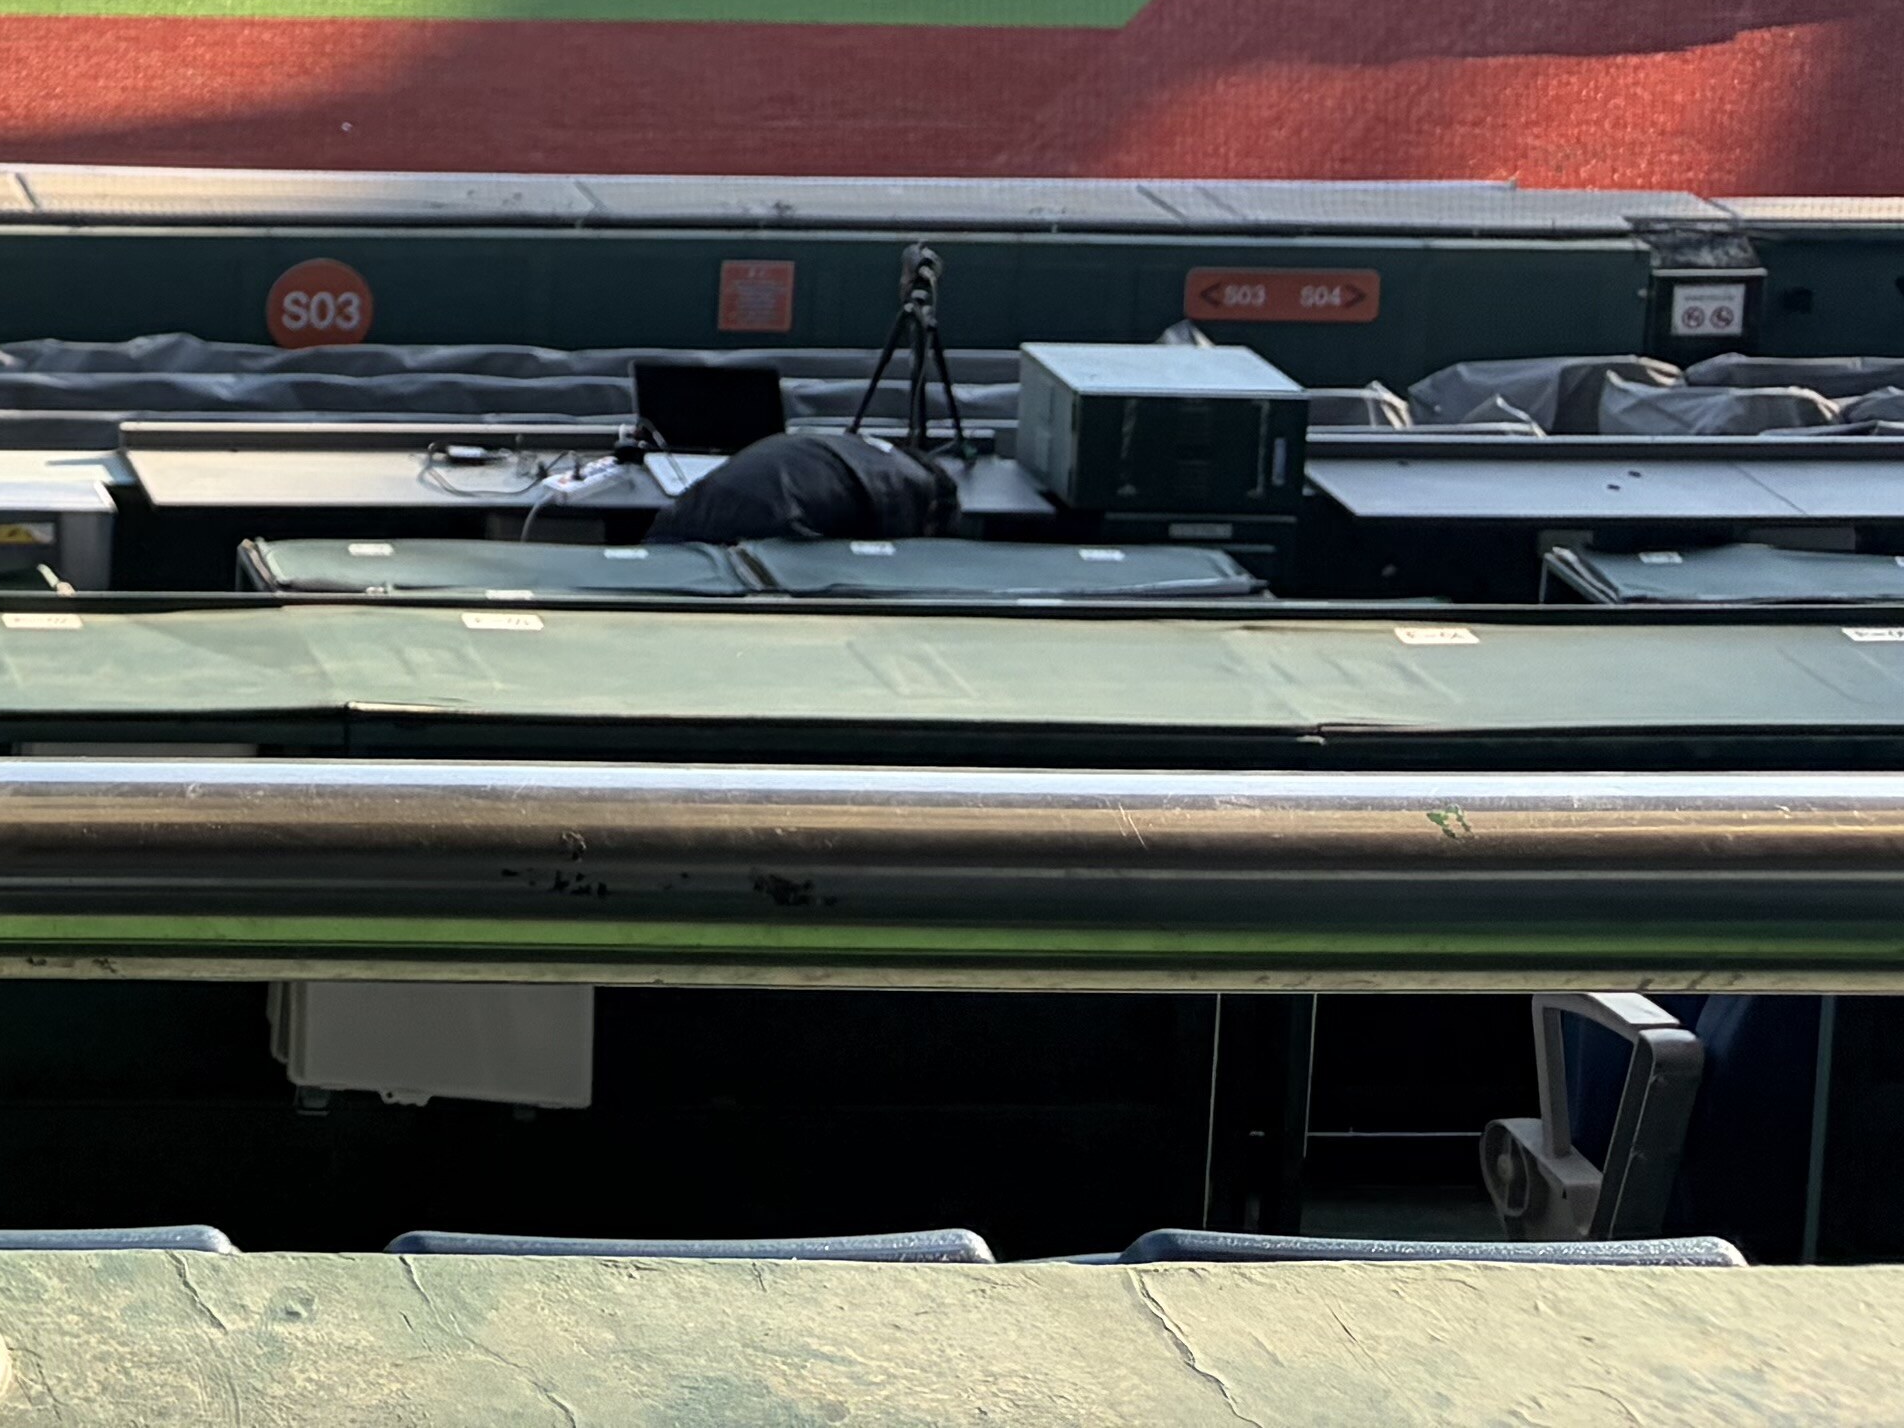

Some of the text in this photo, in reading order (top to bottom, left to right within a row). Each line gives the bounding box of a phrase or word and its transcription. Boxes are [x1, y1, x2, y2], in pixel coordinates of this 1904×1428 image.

[282, 290, 362, 331] S03
[1223, 284, 1342, 307] S03 S04
